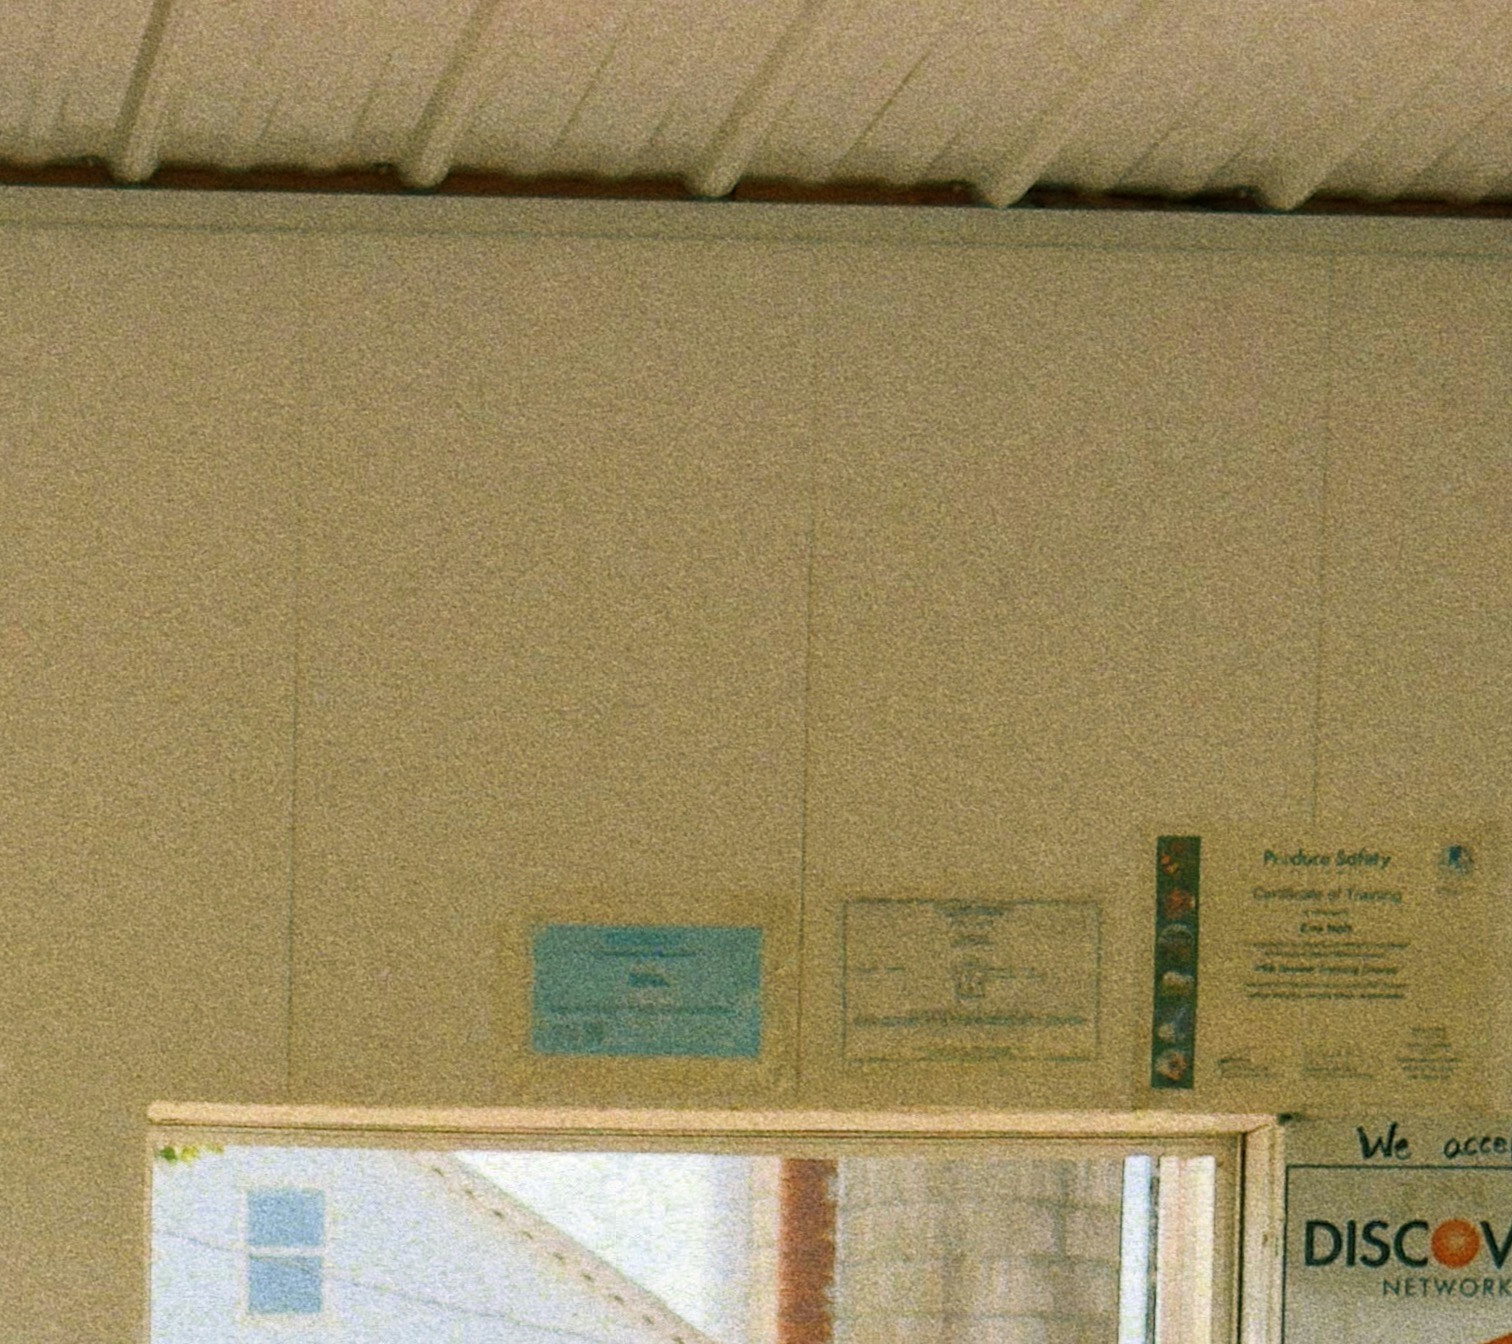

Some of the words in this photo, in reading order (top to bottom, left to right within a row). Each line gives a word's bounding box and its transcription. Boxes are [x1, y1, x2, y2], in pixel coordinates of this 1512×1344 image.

[1336, 847, 1391, 869] Safety
[1356, 1122, 1412, 1160] We
[1443, 1135, 1512, 1160] acce
[1382, 1276, 1512, 1298] NETWORK
